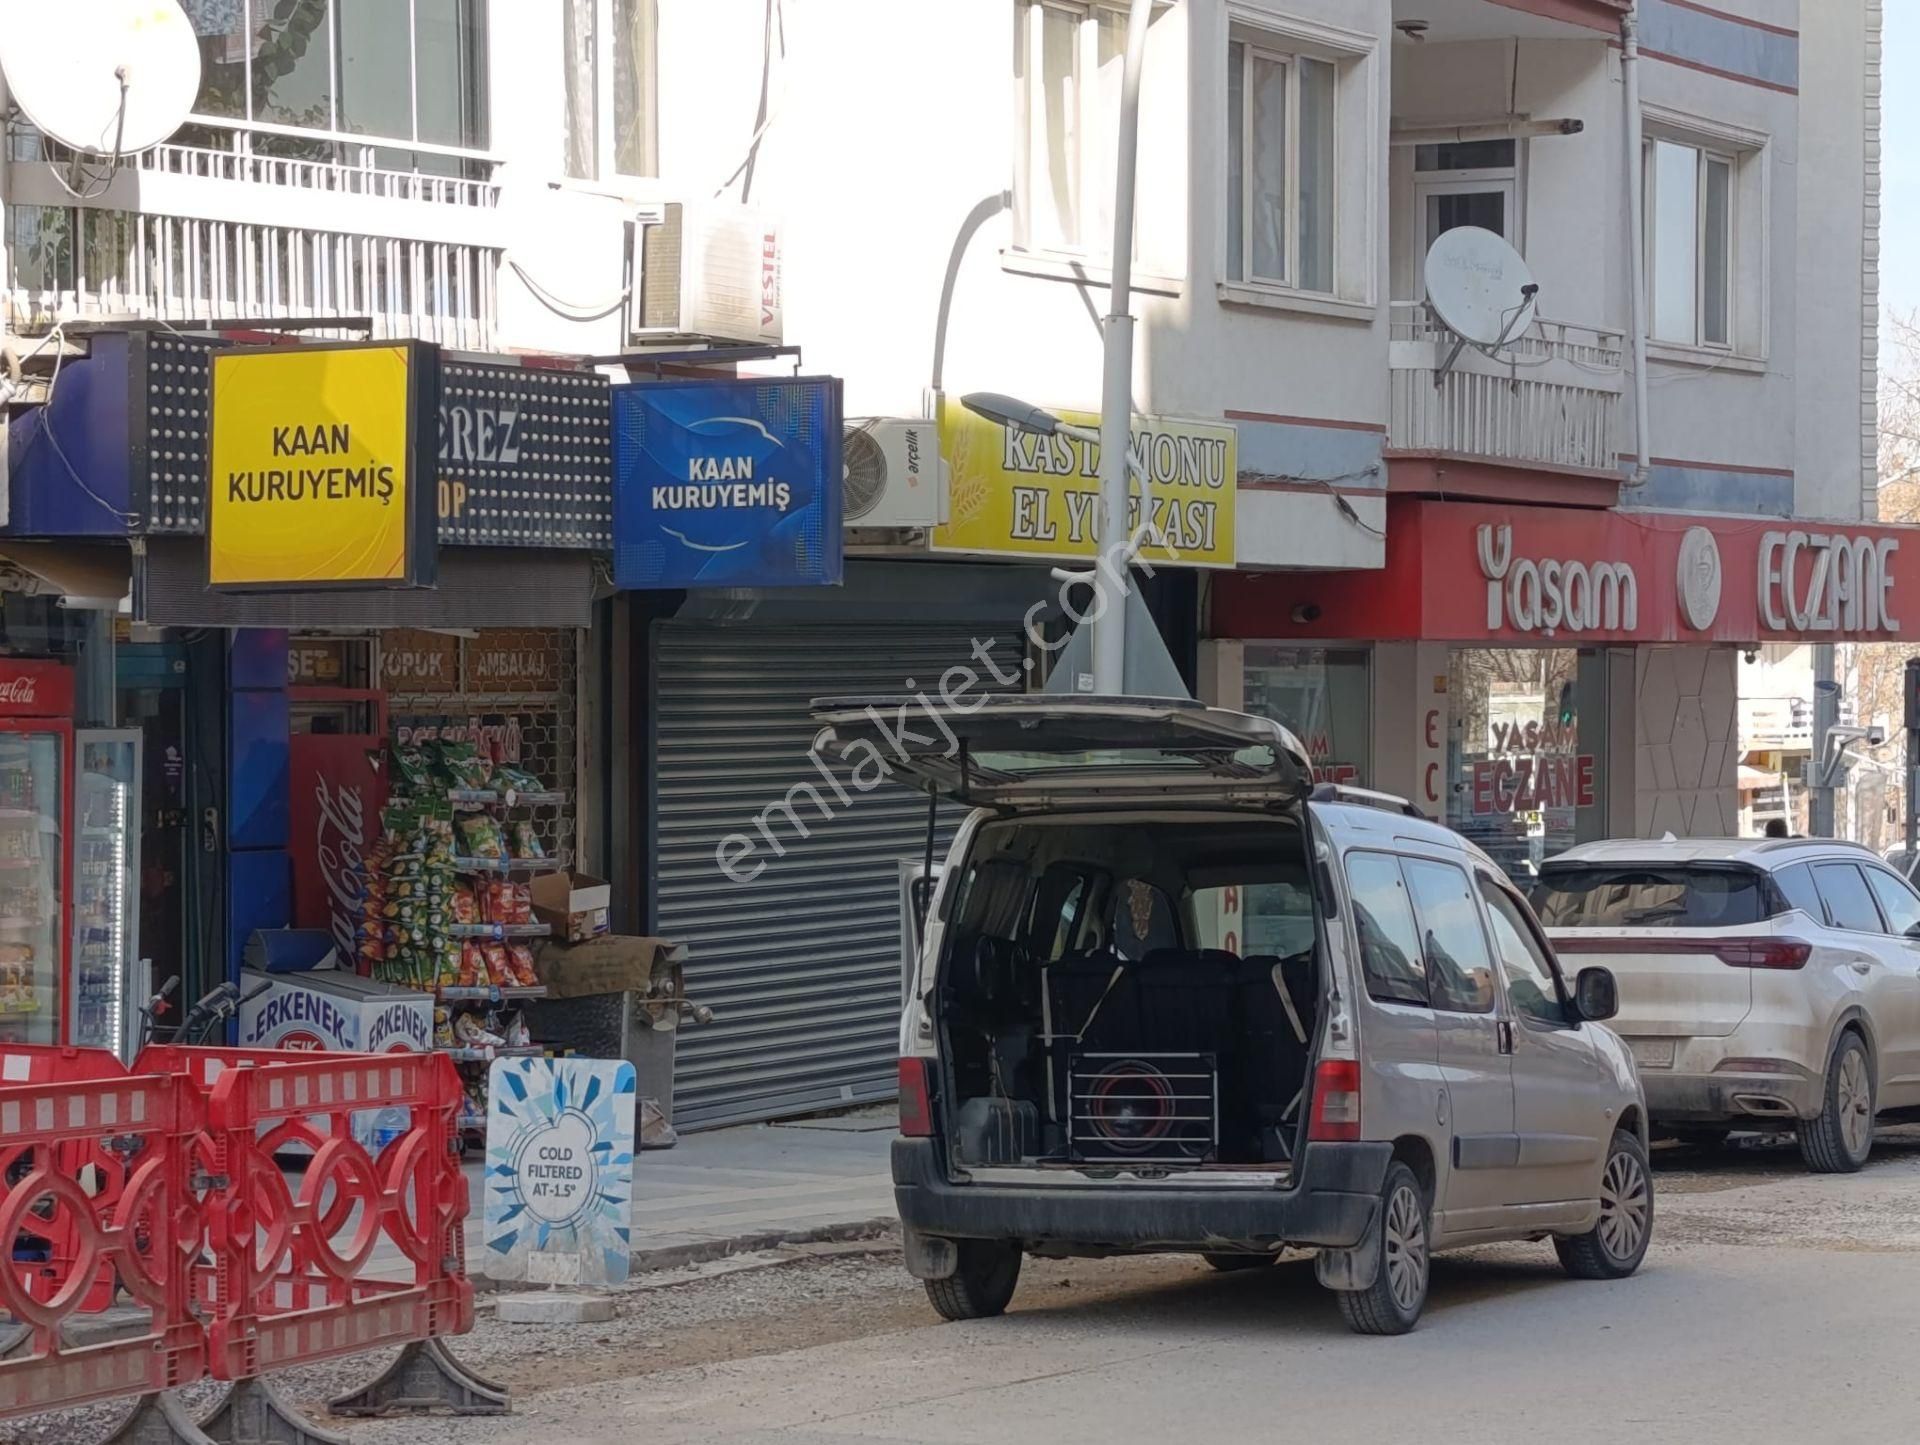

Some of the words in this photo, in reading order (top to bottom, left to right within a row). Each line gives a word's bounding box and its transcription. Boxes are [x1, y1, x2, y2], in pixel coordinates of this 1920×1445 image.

[273, 424, 349, 456] KAAN
[1002, 425, 1227, 489] KASTMONU
[229, 459, 394, 505] KURUYEMİŞ
[689, 457, 752, 481] KAAN
[652, 477, 791, 511] KURUYEMİŞ
[1010, 487, 1057, 541] EL
[1477, 523, 1638, 637] Yaşam
[1757, 530, 1900, 632] ECZANE
[1472, 754, 1595, 815] ECZANE
[256, 992, 345, 1049] ERKENEK
[369, 1004, 428, 1052] ERKENEK
[528, 1164, 583, 1179] FILTERED
[539, 1146, 573, 1160] COLD
